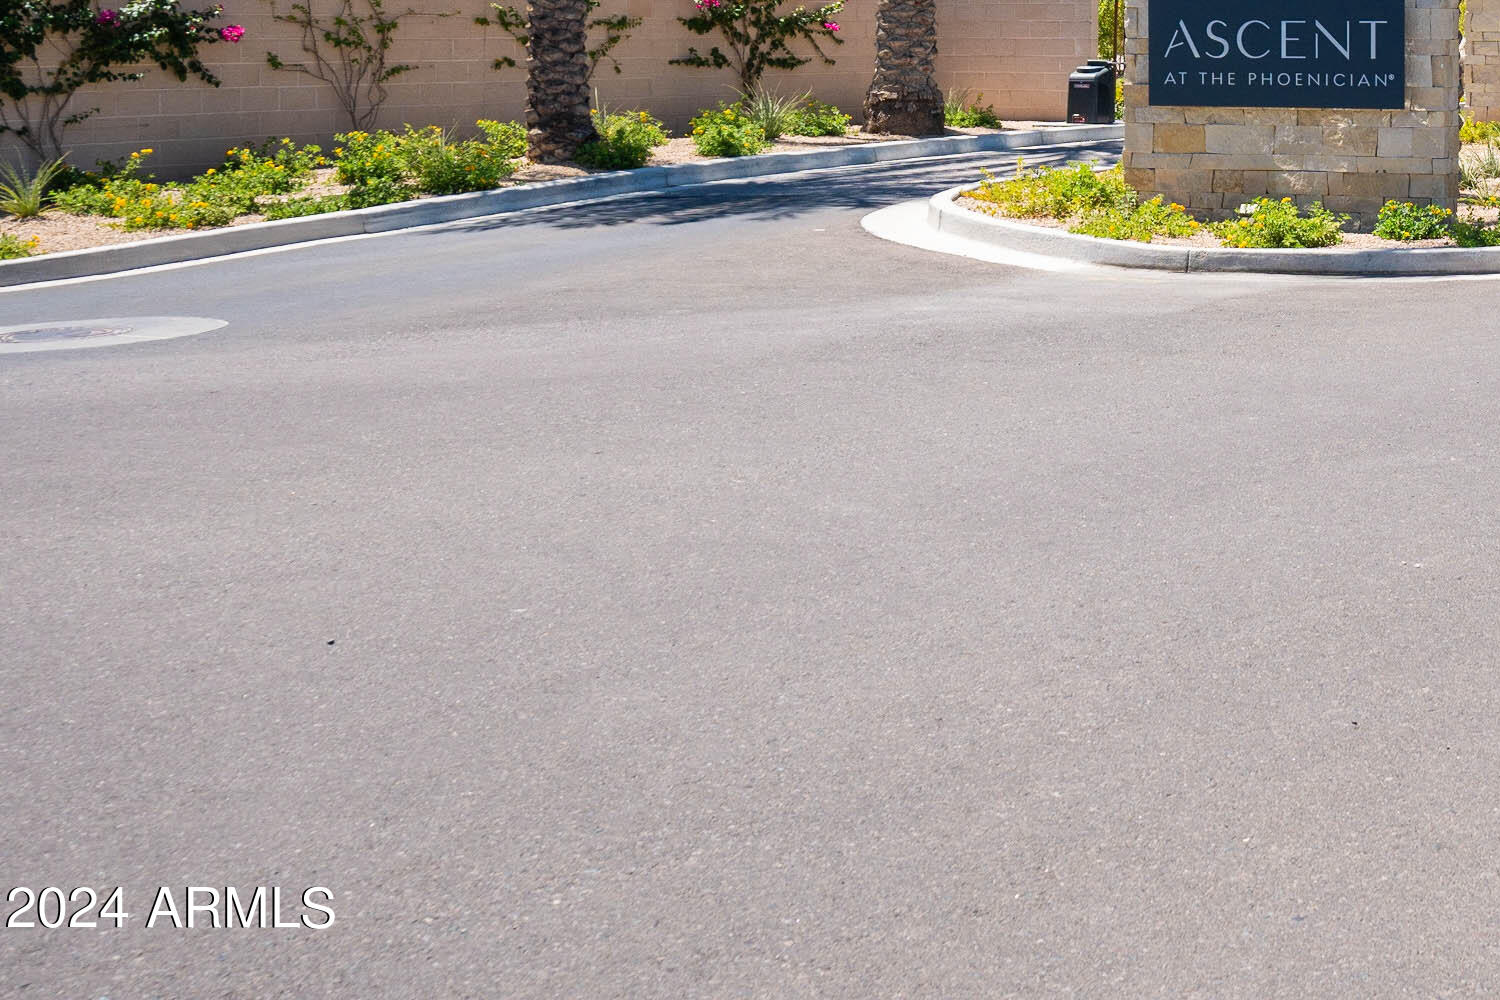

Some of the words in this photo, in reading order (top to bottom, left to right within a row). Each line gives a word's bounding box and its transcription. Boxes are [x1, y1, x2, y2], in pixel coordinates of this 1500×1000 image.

[1164, 19, 1388, 60] ASCENT
[1164, 71, 1188, 85] AT
[1199, 72, 1236, 86] THE
